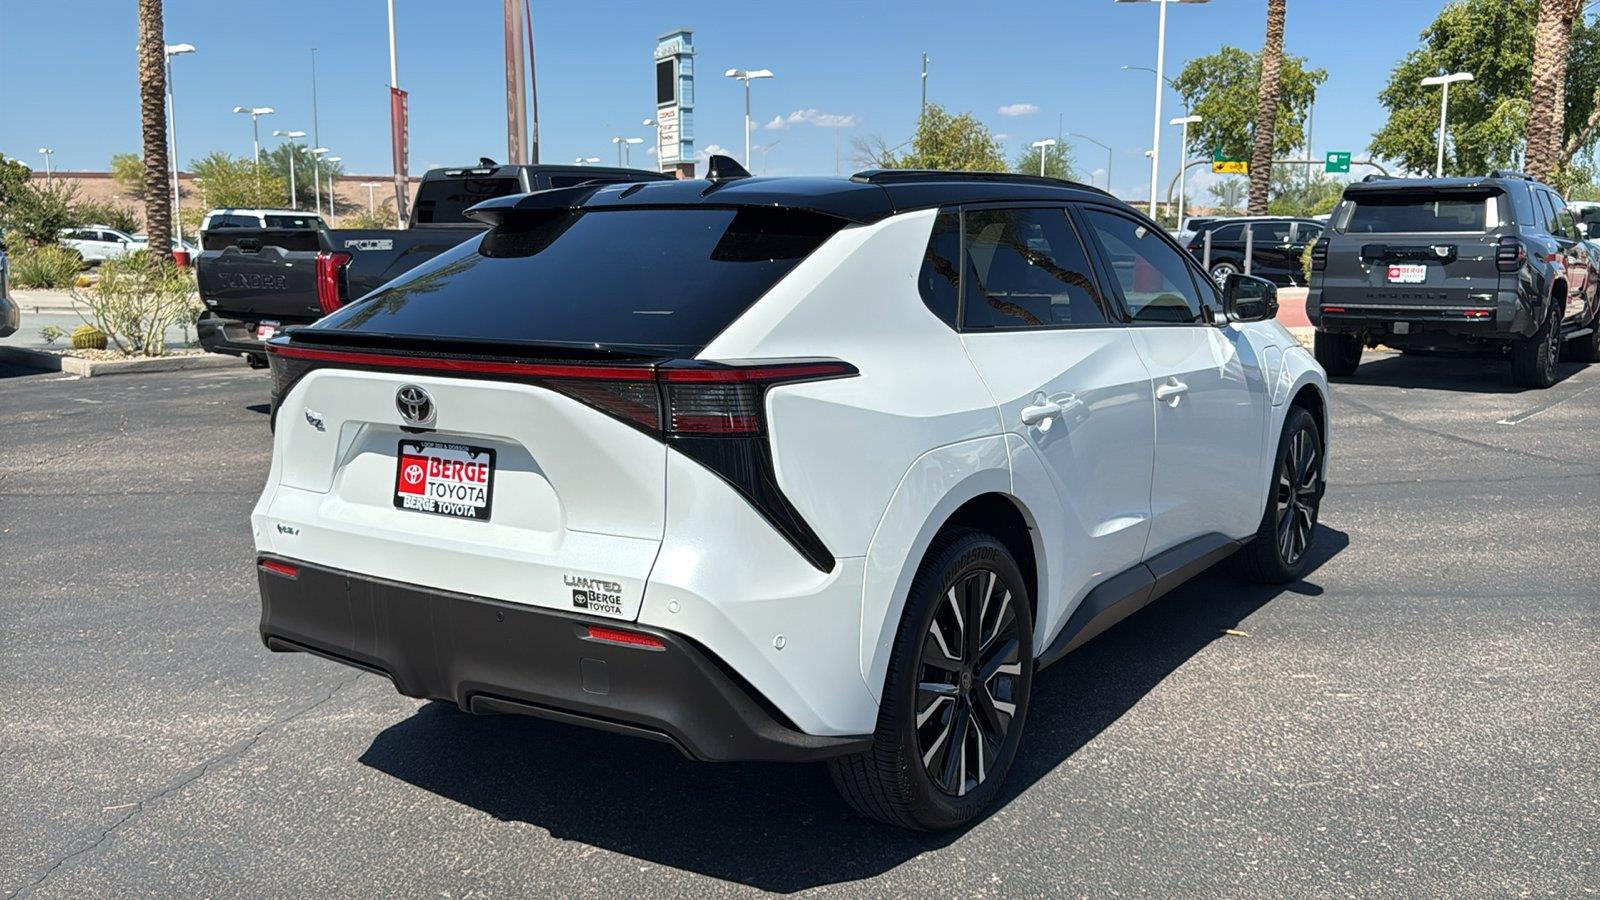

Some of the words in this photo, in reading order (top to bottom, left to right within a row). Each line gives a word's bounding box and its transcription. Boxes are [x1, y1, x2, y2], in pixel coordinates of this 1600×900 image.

[219, 273, 287, 289] TUNDRA
[429, 456, 488, 483] BERGE
[428, 482, 485, 502] TOYOTA
[403, 495, 435, 511] BERGE
[438, 501, 476, 517] TOYOTA
[563, 574, 622, 593] LIMITED
[588, 590, 621, 605] BERGE
[589, 602, 621, 614] TOYOTA
